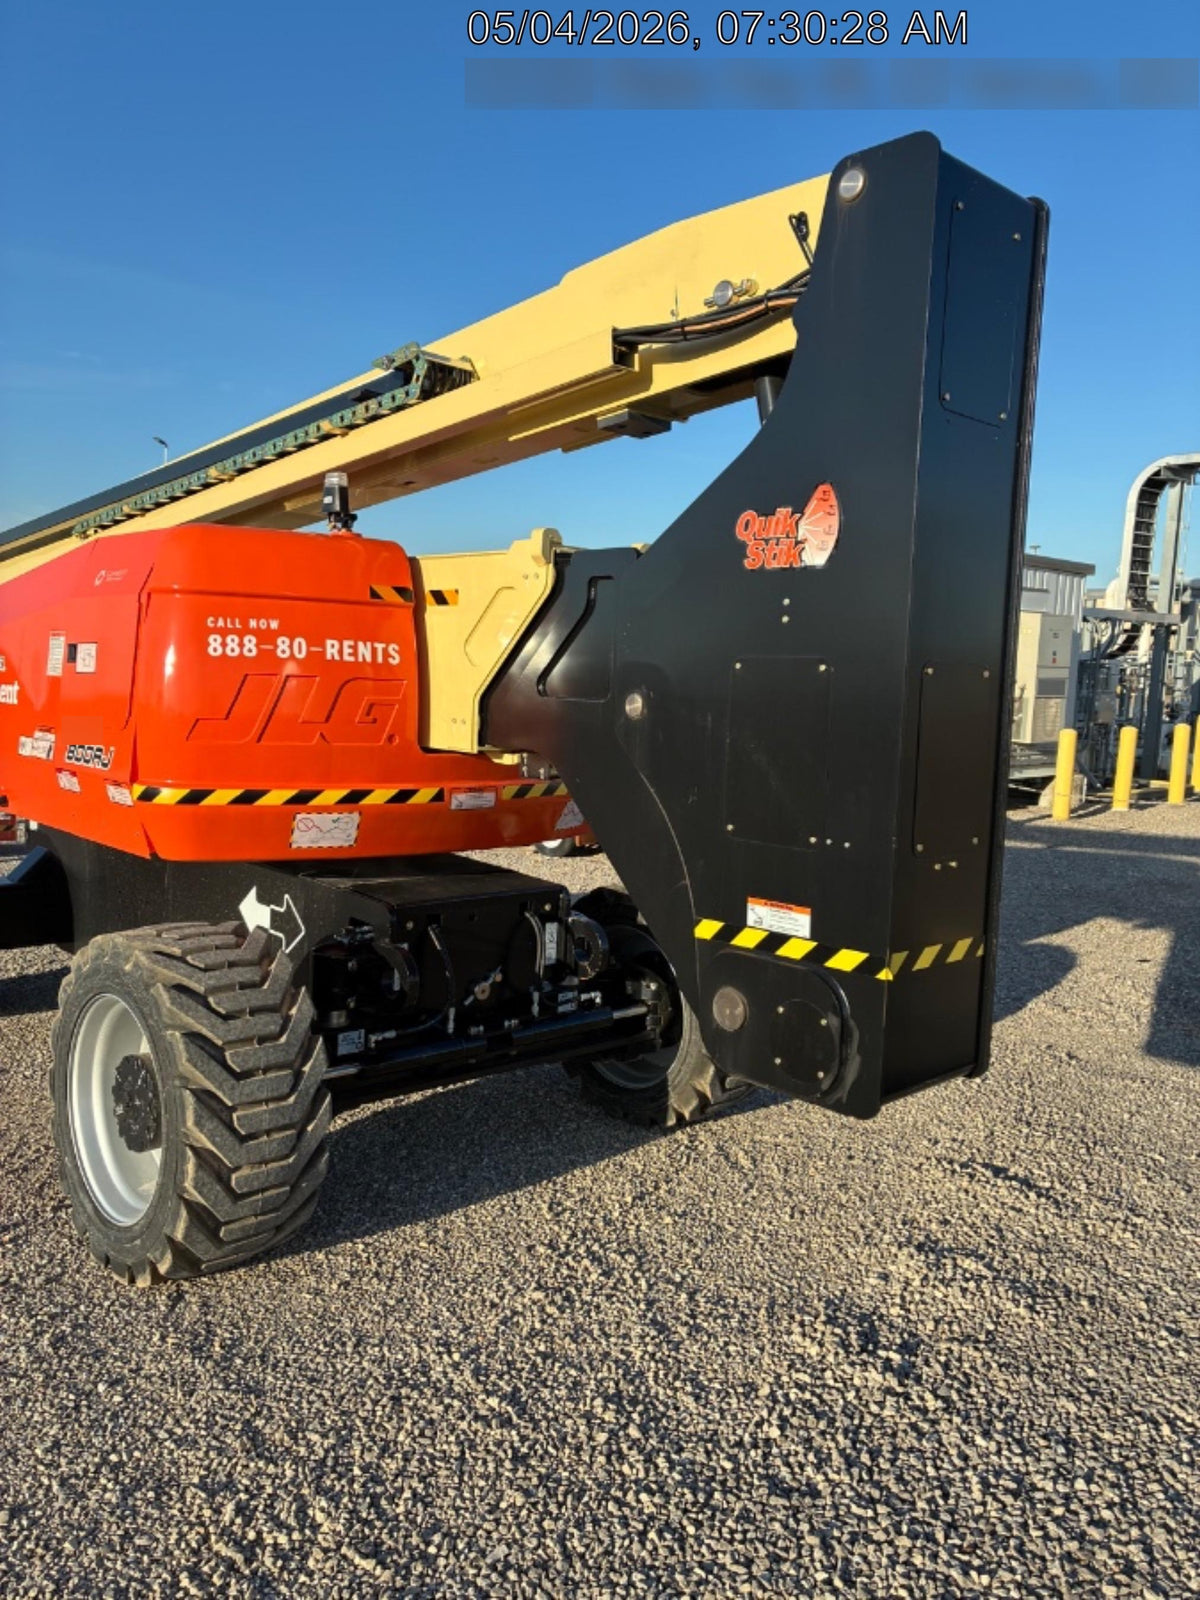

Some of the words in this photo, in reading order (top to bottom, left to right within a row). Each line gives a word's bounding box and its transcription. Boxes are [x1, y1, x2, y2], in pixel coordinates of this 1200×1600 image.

[735, 507, 801, 544] Quik
[743, 537, 804, 570] Stik
[206, 616, 243, 629] CALL
[249, 618, 280, 630] NOW
[207, 633, 401, 666] 888-80-RENTS
